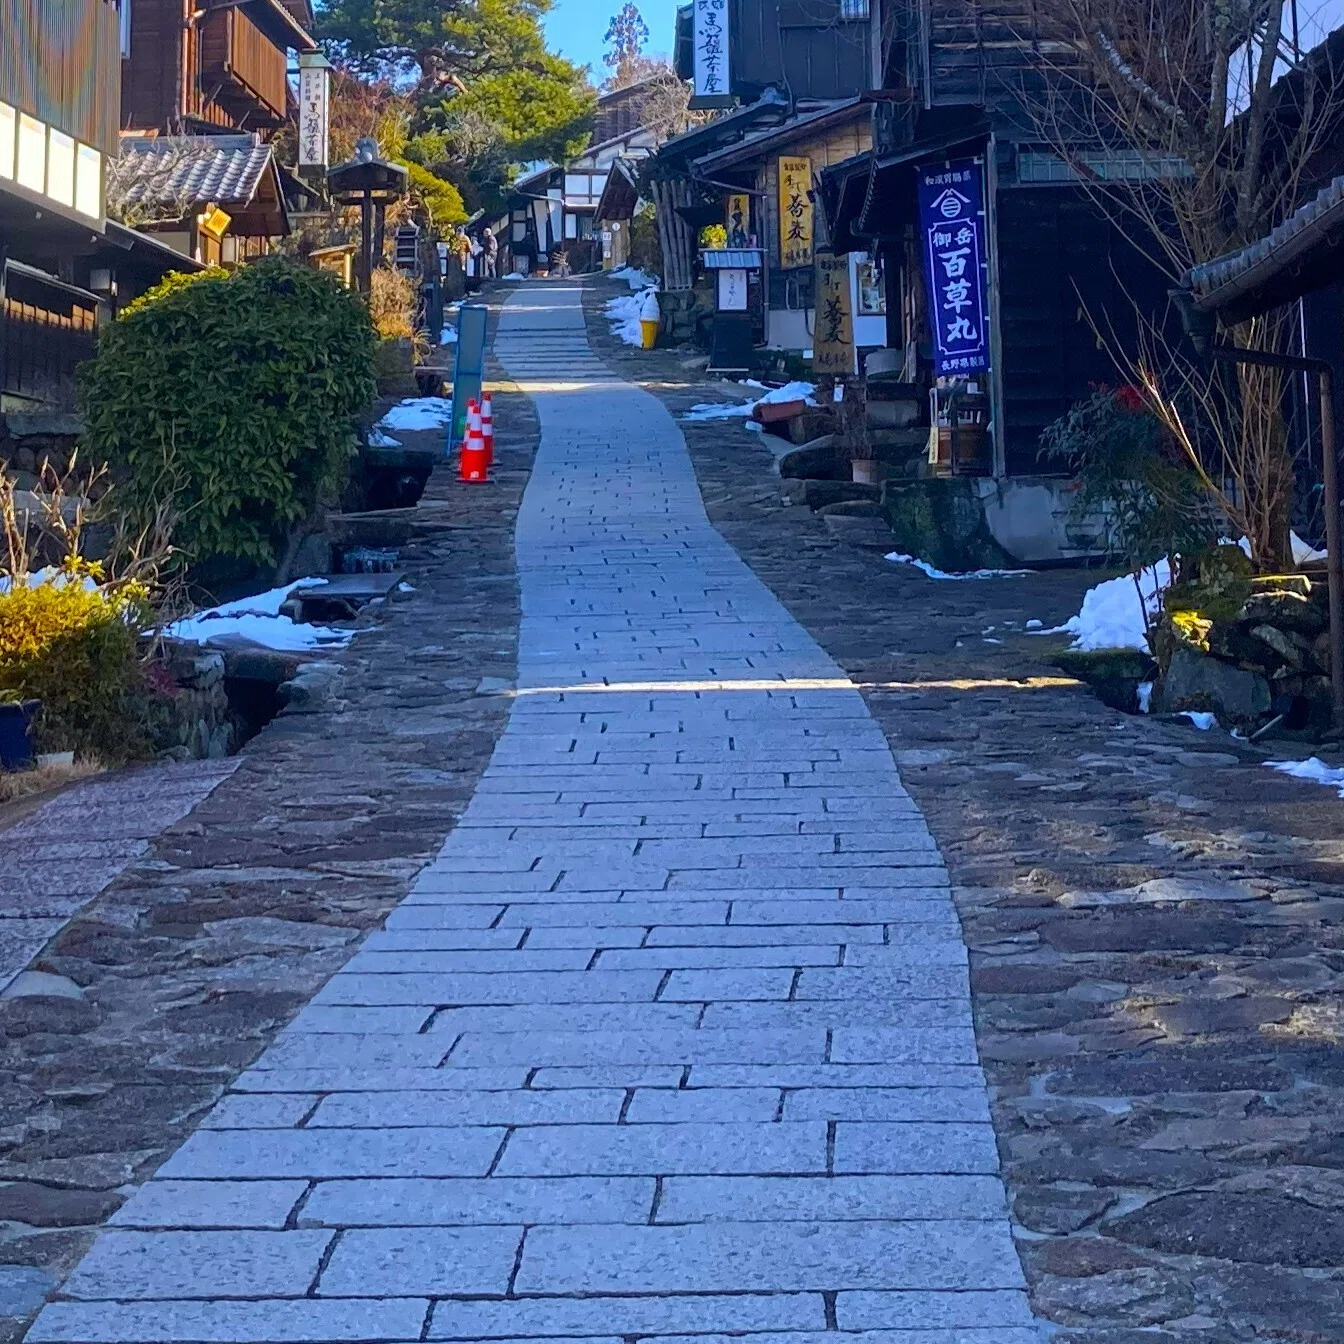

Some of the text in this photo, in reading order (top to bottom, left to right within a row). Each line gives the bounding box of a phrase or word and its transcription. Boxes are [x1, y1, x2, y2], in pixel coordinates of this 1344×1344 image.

[698, 12, 723, 93] 馬籠茶屋
[932, 227, 974, 248] 御岳
[938, 247, 977, 342] 百草丸
